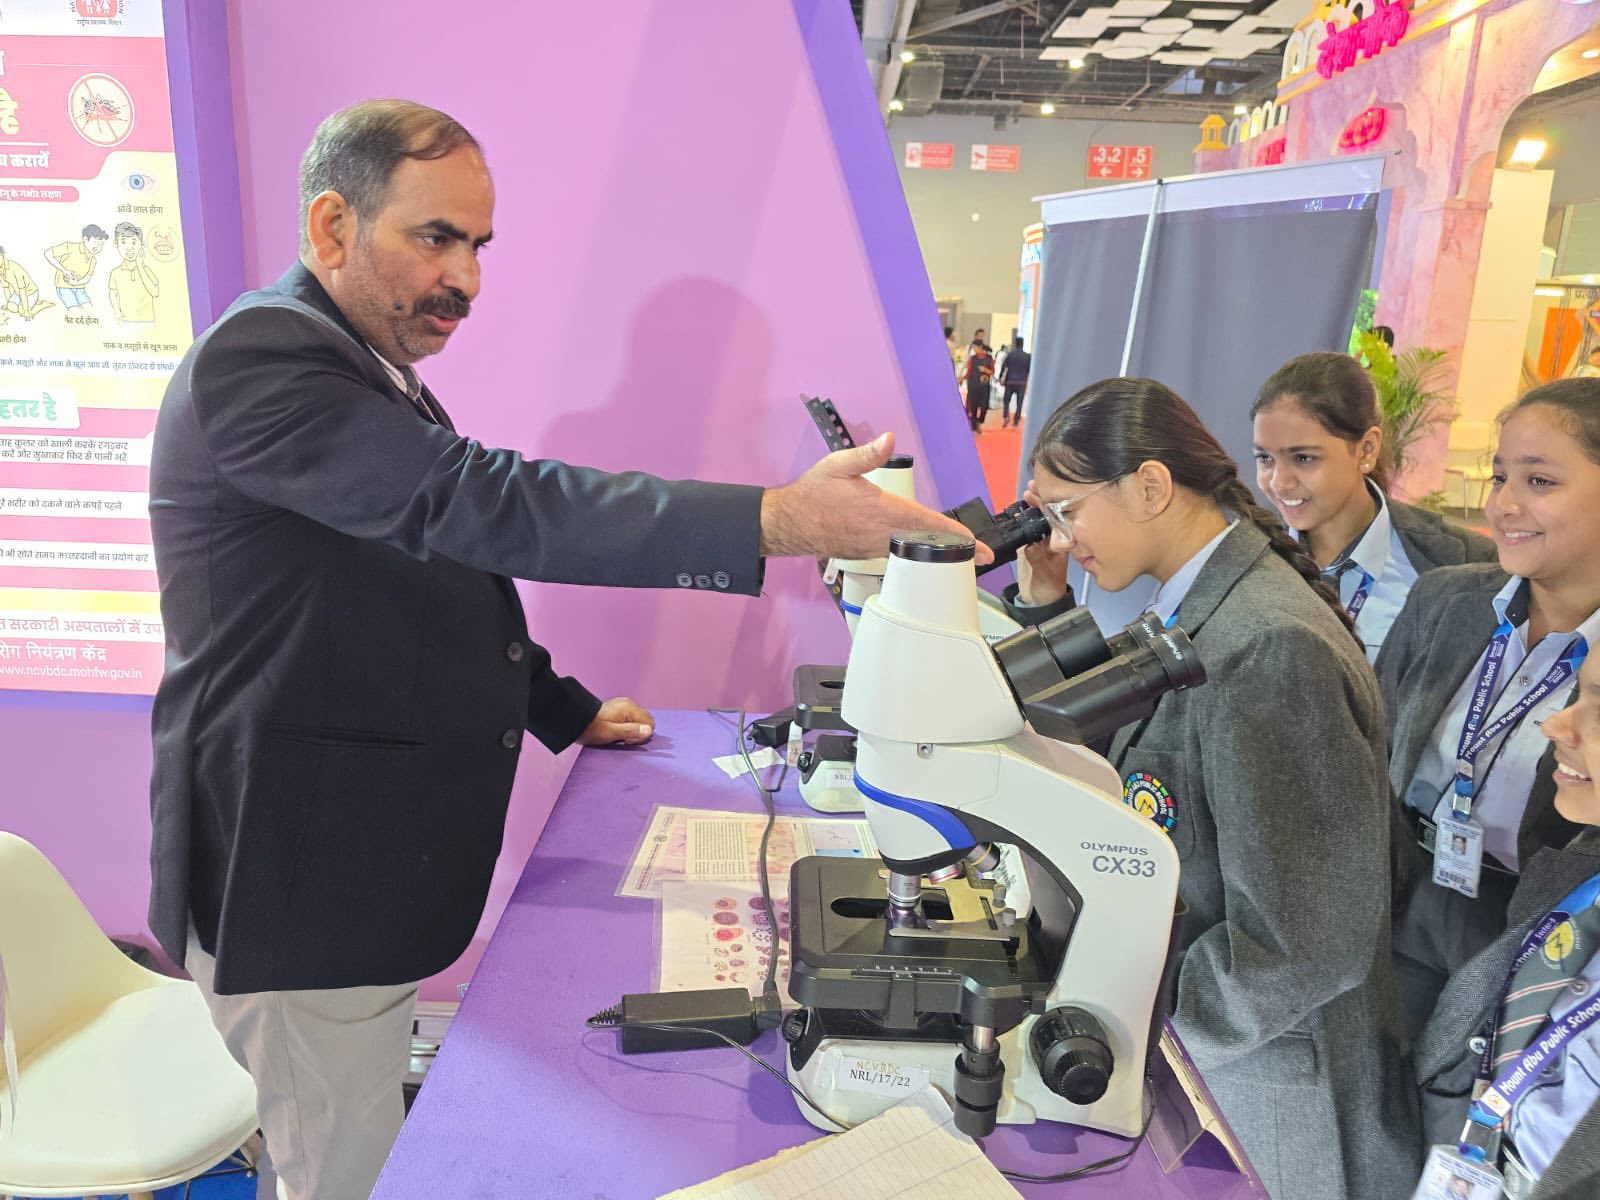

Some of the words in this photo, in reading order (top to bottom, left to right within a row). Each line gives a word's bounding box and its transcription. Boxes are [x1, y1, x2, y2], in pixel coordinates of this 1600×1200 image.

[42, 391, 57, 421] है
[37, 438, 48, 448] को
[51, 438, 72, 449] खाली
[74, 439, 96, 449] करके
[17, 448, 31, 459] और
[67, 449, 83, 460] फिर
[84, 450, 92, 461] से
[28, 498, 39, 508] को
[35, 551, 55, 559] समय
[99, 552, 110, 560] का
[9, 616, 59, 632] सरकारी
[64, 618, 125, 634] अस्पतालों
[129, 619, 140, 634] में
[143, 623, 162, 634] उप
[25, 639, 77, 661] नियंत्रण
[1473, 688, 1488, 713] Public
[1481, 661, 1497, 687] School
[1485, 723, 1501, 738] Abu
[1500, 706, 1525, 725] Public
[1522, 684, 1548, 706] School
[1080, 841, 1149, 856] OLYMPUS
[1092, 855, 1156, 878] CX33
[1498, 1066, 1527, 1096] Mount
[1522, 1050, 1544, 1073] Abu
[1539, 1025, 1570, 1055] Public
[850, 1068, 911, 1087] NRL/17/22
